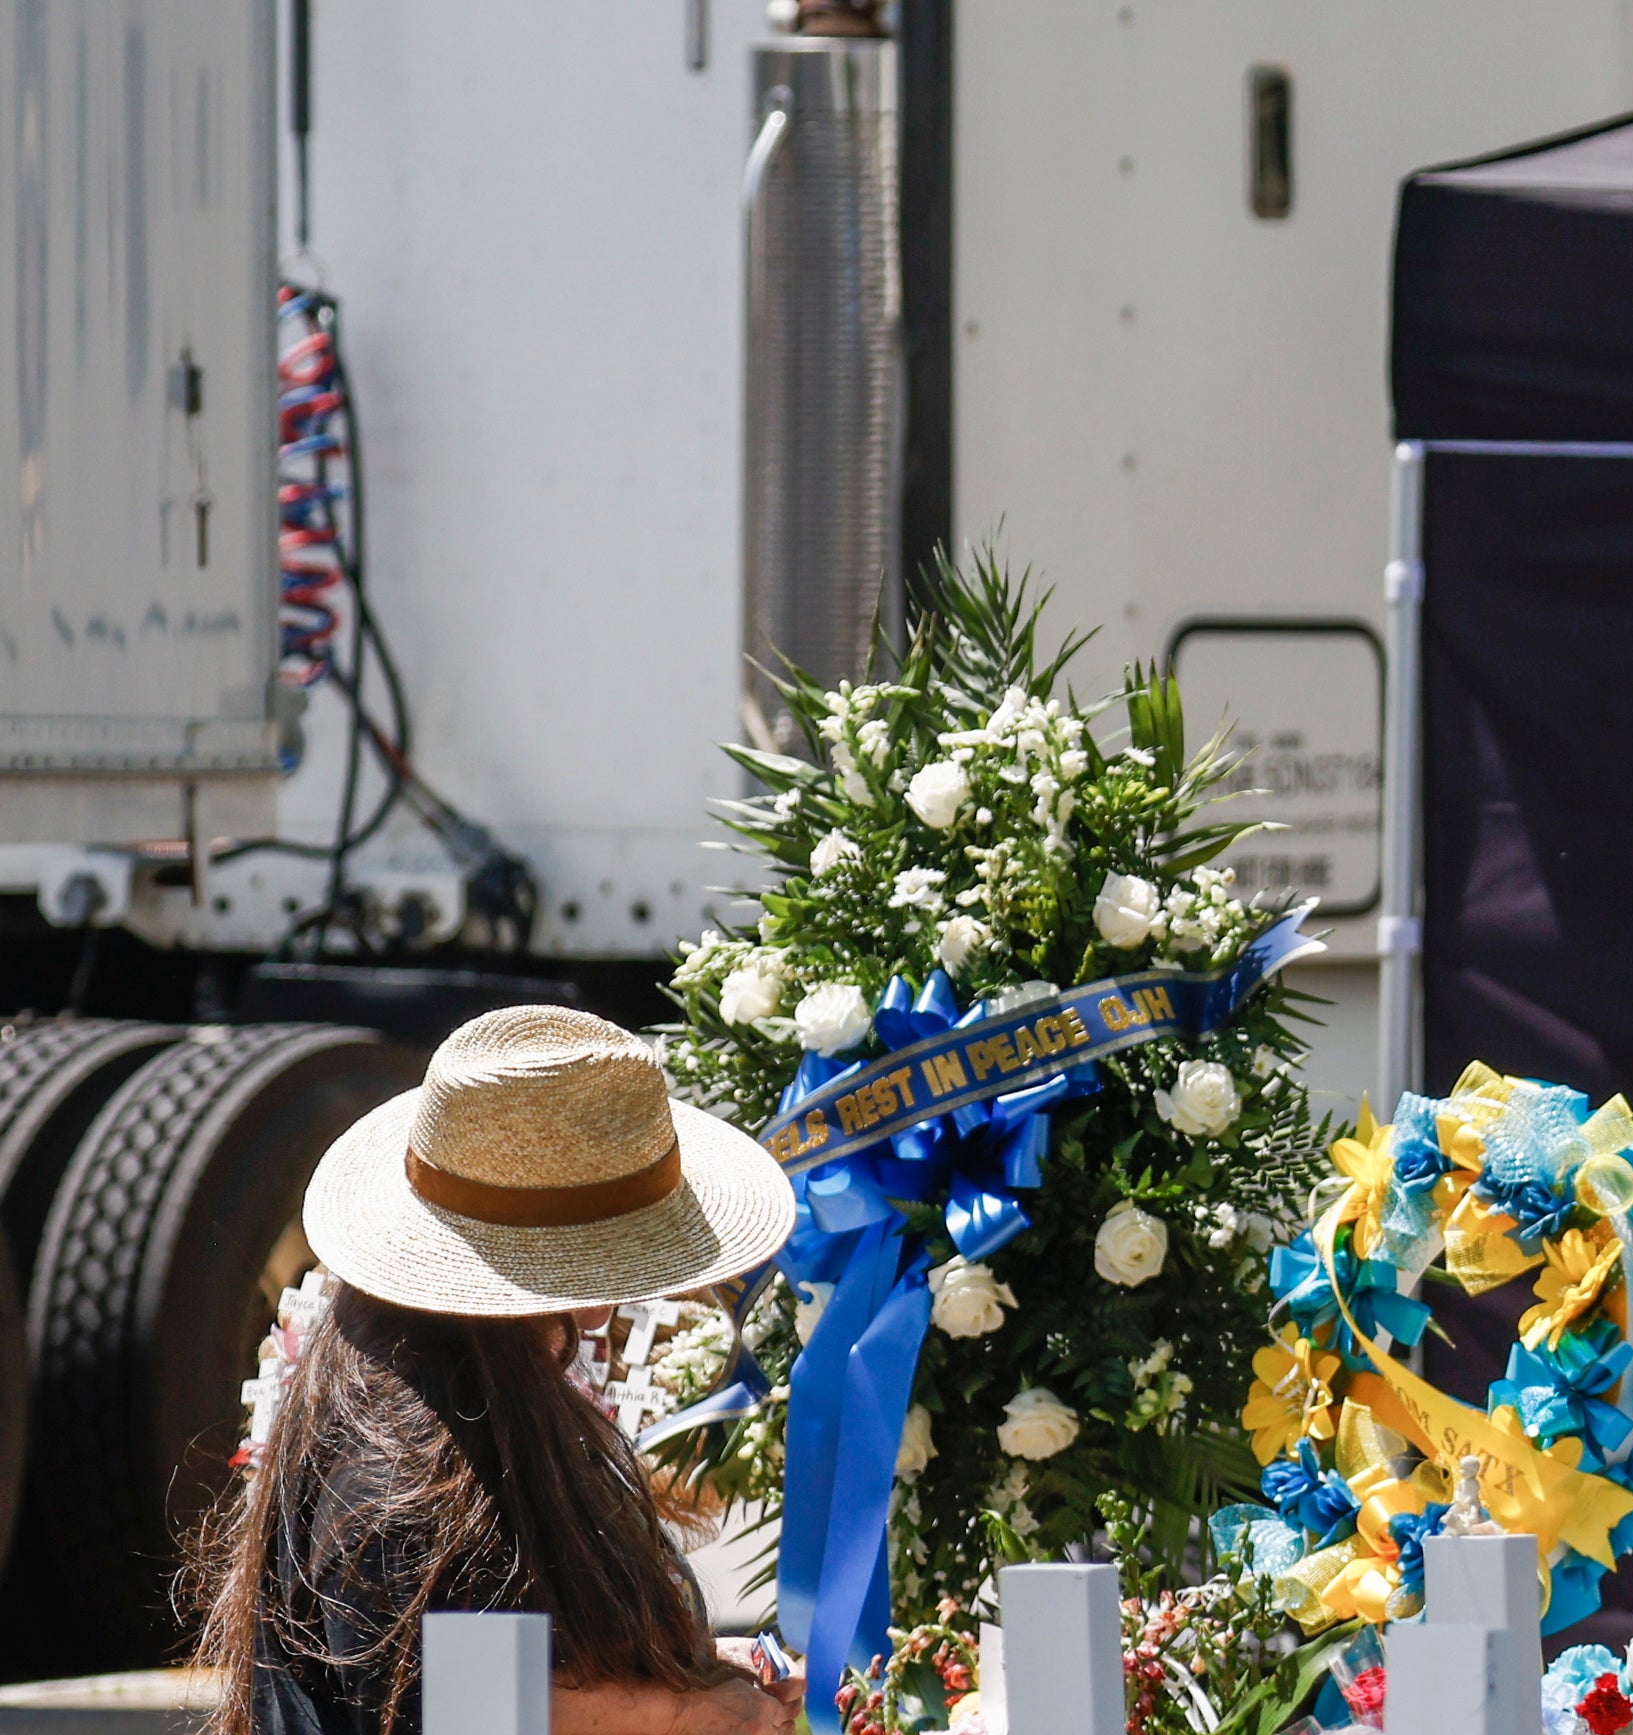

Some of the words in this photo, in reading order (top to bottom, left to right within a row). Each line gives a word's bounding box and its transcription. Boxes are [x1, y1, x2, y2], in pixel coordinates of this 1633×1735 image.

[838, 1065, 915, 1137] REST
[920, 1050, 967, 1098] IN
[968, 1006, 1090, 1083] PEACE
[1097, 986, 1177, 1033] OJH
[1440, 1426, 1524, 1497] SATX
